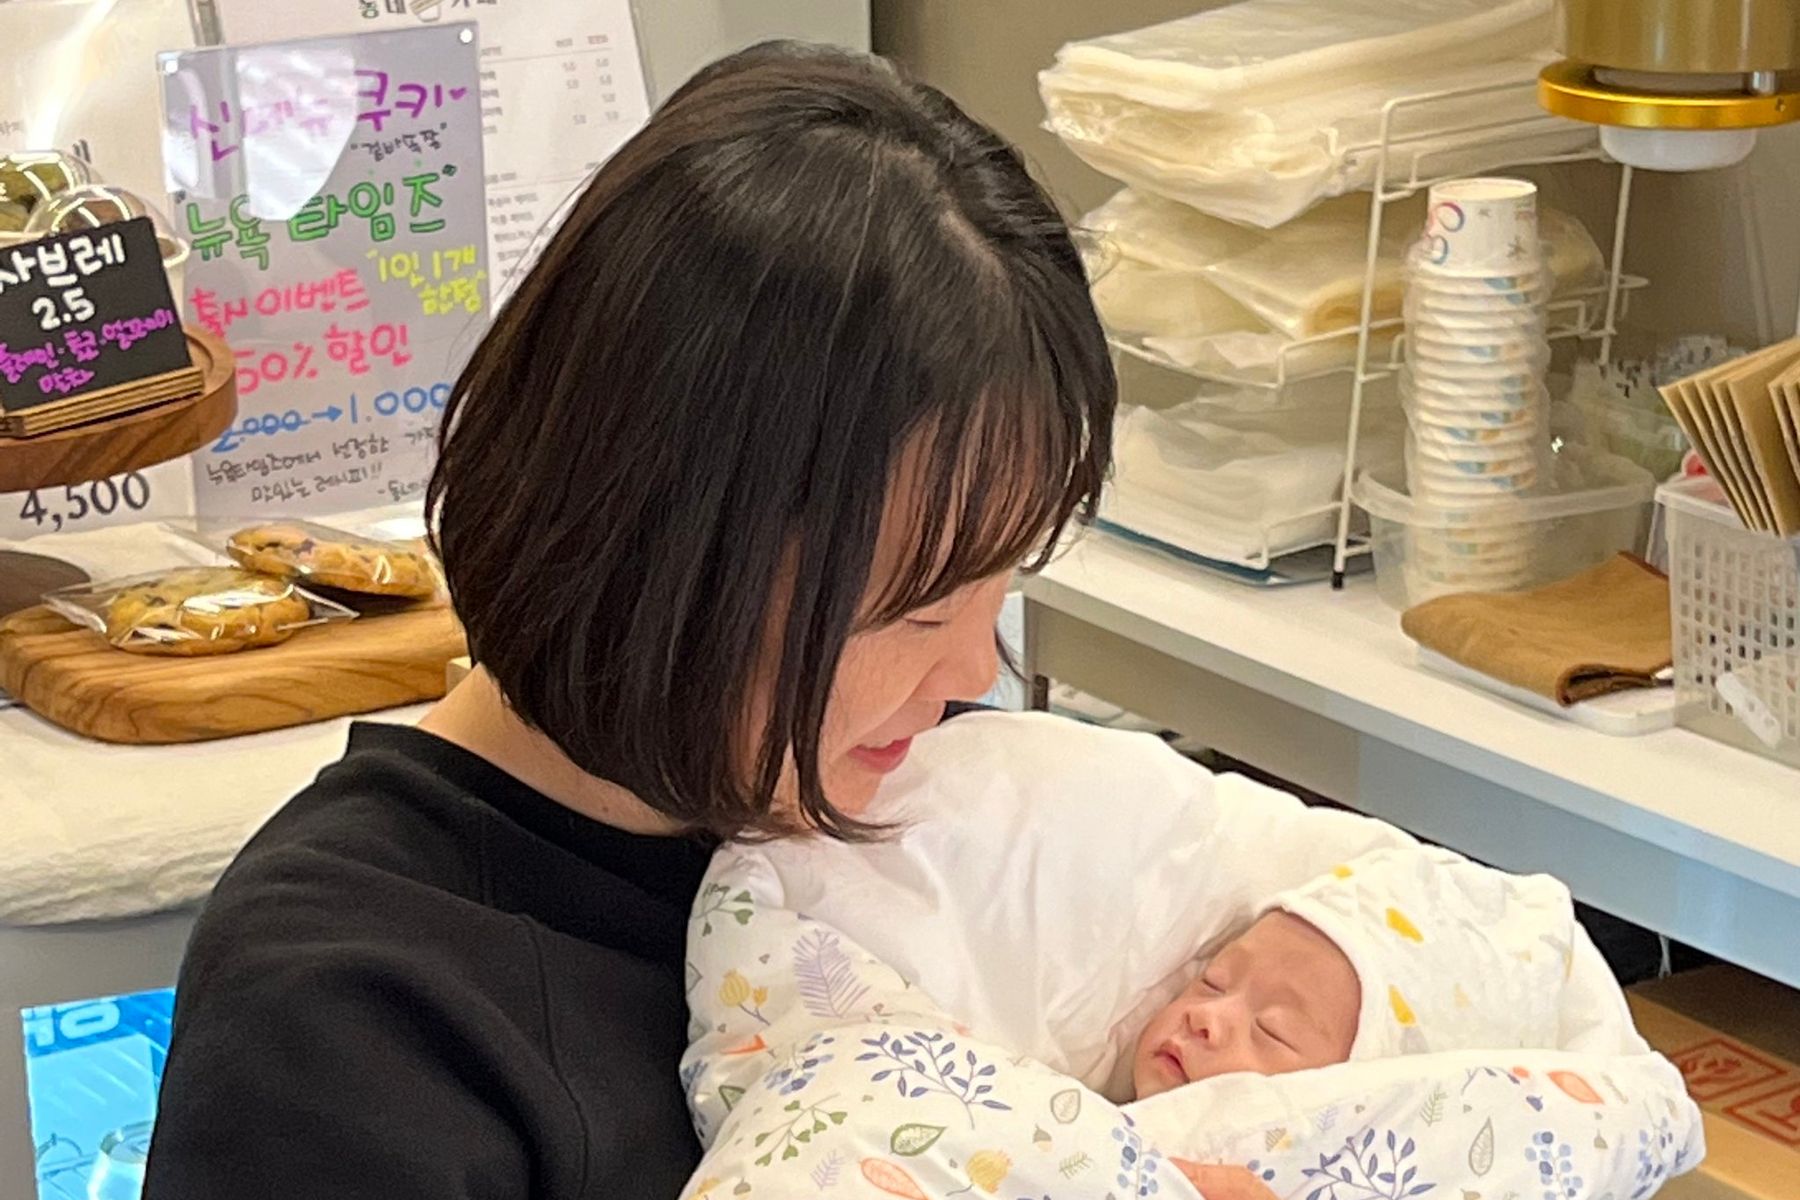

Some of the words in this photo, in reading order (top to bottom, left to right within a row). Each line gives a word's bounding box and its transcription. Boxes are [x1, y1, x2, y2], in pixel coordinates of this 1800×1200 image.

[354, 69, 442, 132] 쿠키
[0, 233, 126, 293] 사브레
[255, 268, 370, 312] 이벤트
[32, 287, 95, 331] 2.5
[234, 343, 318, 395] 50%
[323, 323, 413, 376] 할인
[350, 383, 453, 424] 1.000
[20, 471, 150, 532] 4,500
